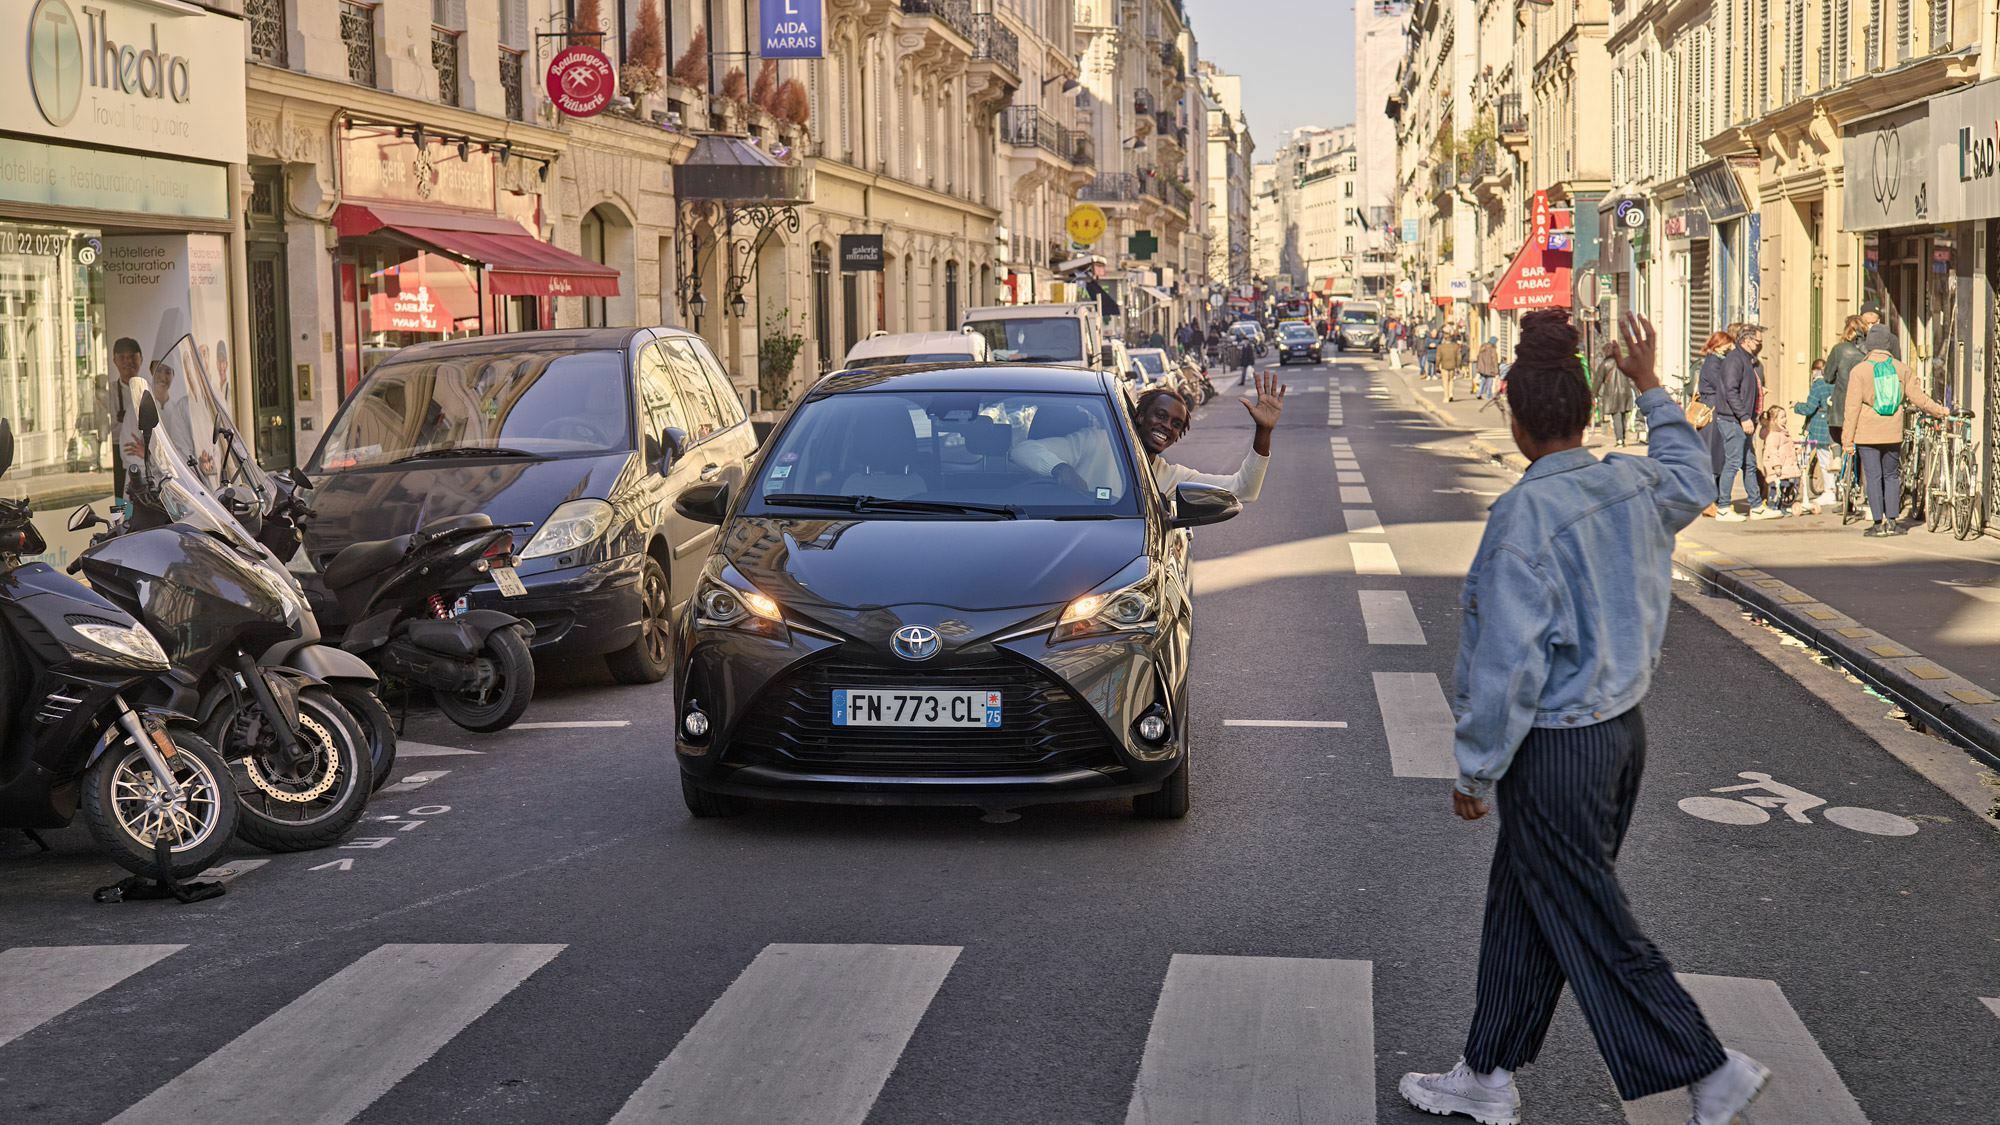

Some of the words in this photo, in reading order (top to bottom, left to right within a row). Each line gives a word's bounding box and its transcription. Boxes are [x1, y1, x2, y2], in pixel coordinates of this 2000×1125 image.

[774, 22, 808, 34] AIDA
[767, 36, 816, 48] MARAIS
[82, 5, 190, 104] Thedra
[551, 52, 609, 76] Boulangerie
[130, 103, 189, 138] Tempaire
[70, 165, 142, 194] Restauration
[1536, 195, 1546, 244] TABAC
[18, 232, 32, 254] 22
[36, 233, 50, 255] 02
[110, 245, 165, 258] Hôtellerie
[846, 252, 878, 260] miranda
[103, 260, 175, 272] Restauration
[1521, 267, 1545, 277] BAR
[118, 273, 160, 285] Traiteur
[1516, 278, 1551, 289] TABAC
[1513, 296, 1526, 305] LE
[1528, 294, 1553, 304] NAVY
[836, 710, 842, 718] F
[851, 694, 981, 723] FN-773-CL
[986, 711, 1001, 723] 75
